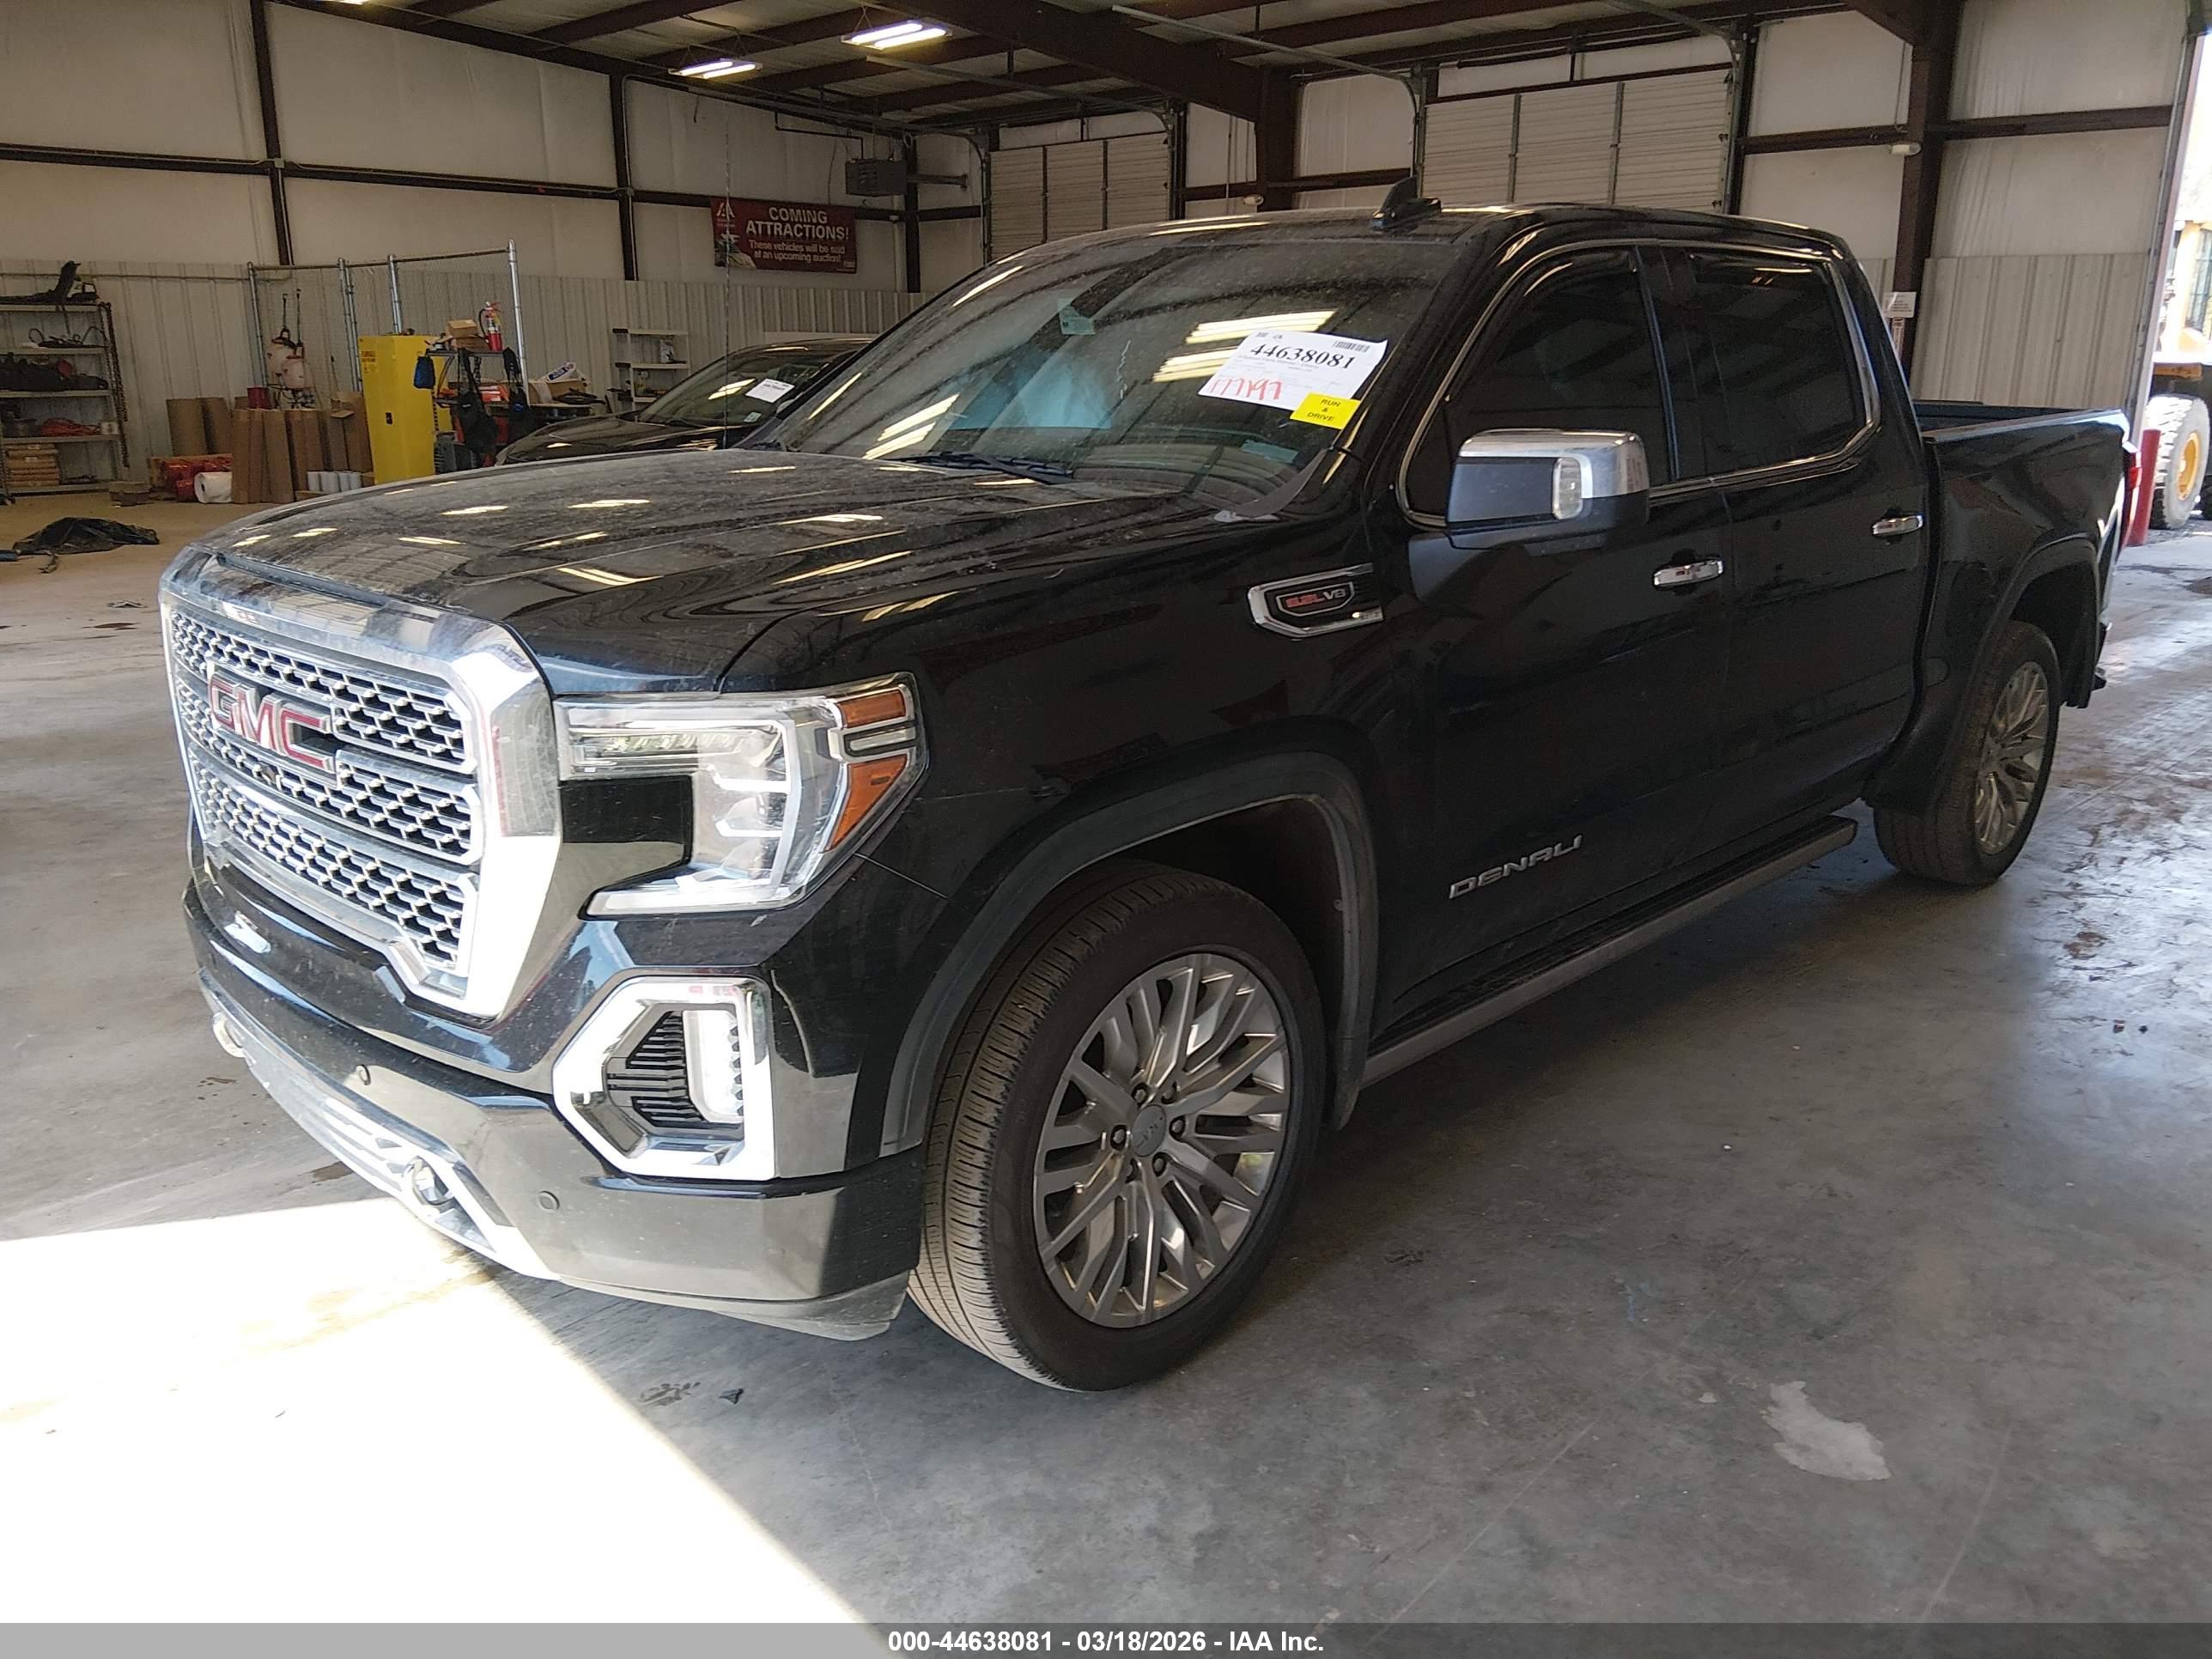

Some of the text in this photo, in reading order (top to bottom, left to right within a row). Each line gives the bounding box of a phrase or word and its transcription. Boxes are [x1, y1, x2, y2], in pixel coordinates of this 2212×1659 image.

[769, 207, 828, 223] COMING
[746, 220, 849, 240] ATTRACTIONS!
[749, 240, 846, 254] These vehicles will be sold
[754, 250, 842, 264] at an upcoming auction!
[1250, 343, 1356, 369] 44638081
[1320, 398, 1341, 407] RUN
[1307, 412, 1334, 421] DRIVE
[209, 672, 336, 775] GMC
[1449, 835, 1583, 899] DENALI
